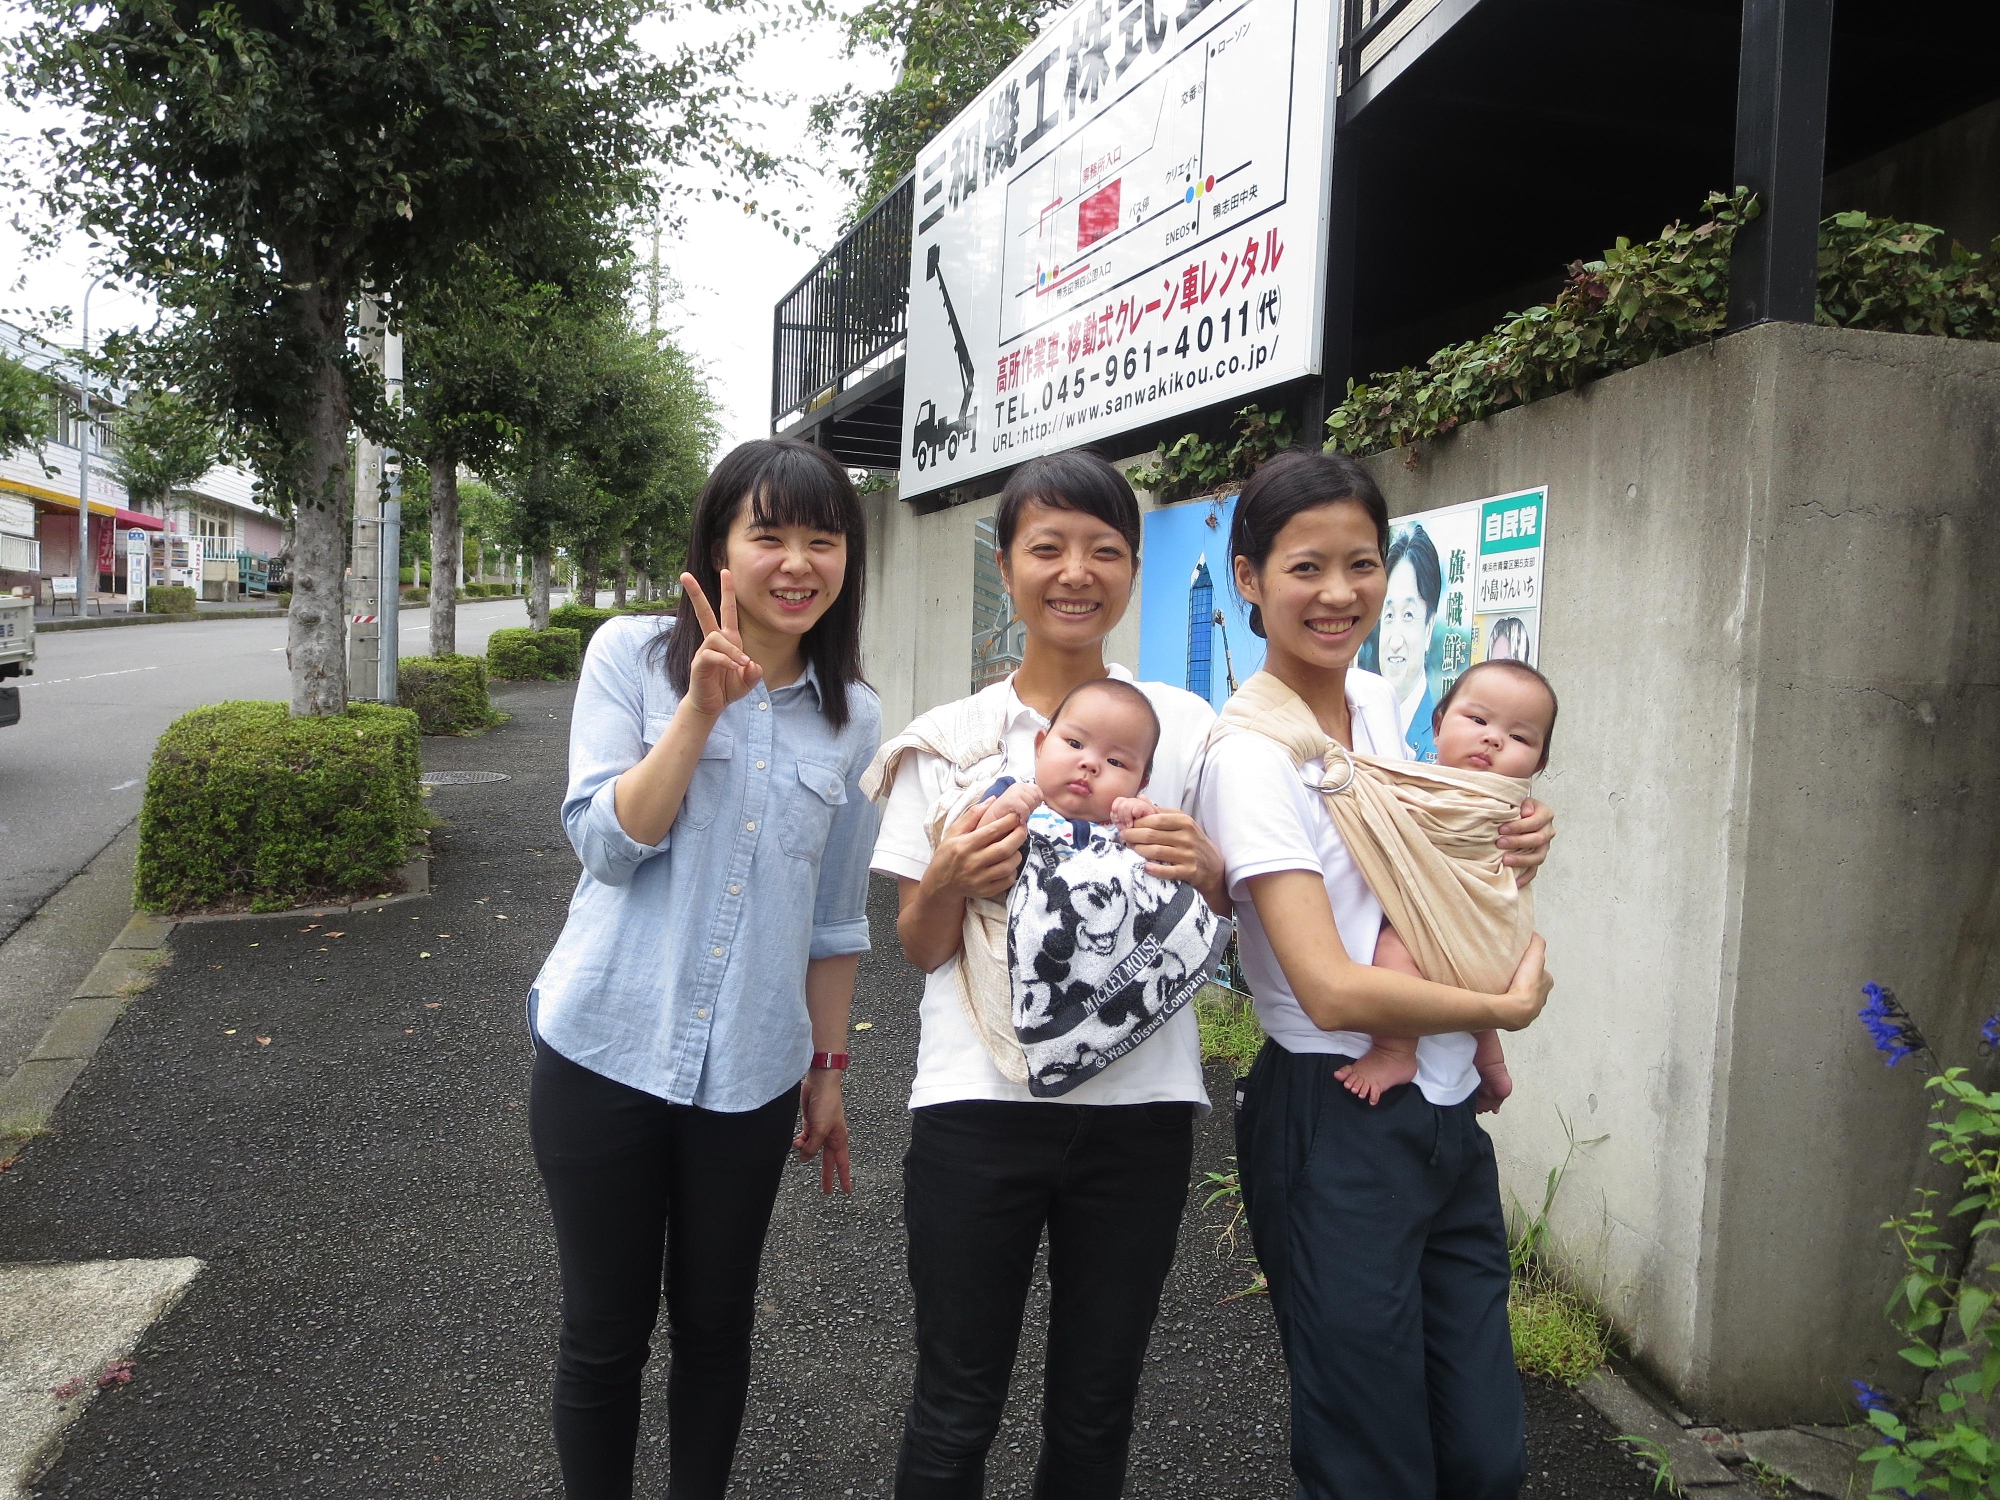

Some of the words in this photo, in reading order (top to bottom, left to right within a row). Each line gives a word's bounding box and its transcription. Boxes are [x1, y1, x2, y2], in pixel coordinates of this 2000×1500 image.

[1218, 22, 1250, 54] ローソン
[1082, 145, 1121, 184] 事務所入口
[1166, 154, 1198, 185] クリエイト
[1129, 196, 1150, 218] バス停
[1213, 184, 1258, 219] 鴨志田中央
[1166, 222, 1190, 246] ENEOS
[1485, 505, 1538, 542] 自民党
[1480, 576, 1534, 602] 小島けんいち
[1081, 969, 1124, 1015] MICKEY
[1121, 933, 1161, 979] MOUSE
[1131, 1012, 1167, 1044] Disney
[1163, 969, 1210, 1014] Company
